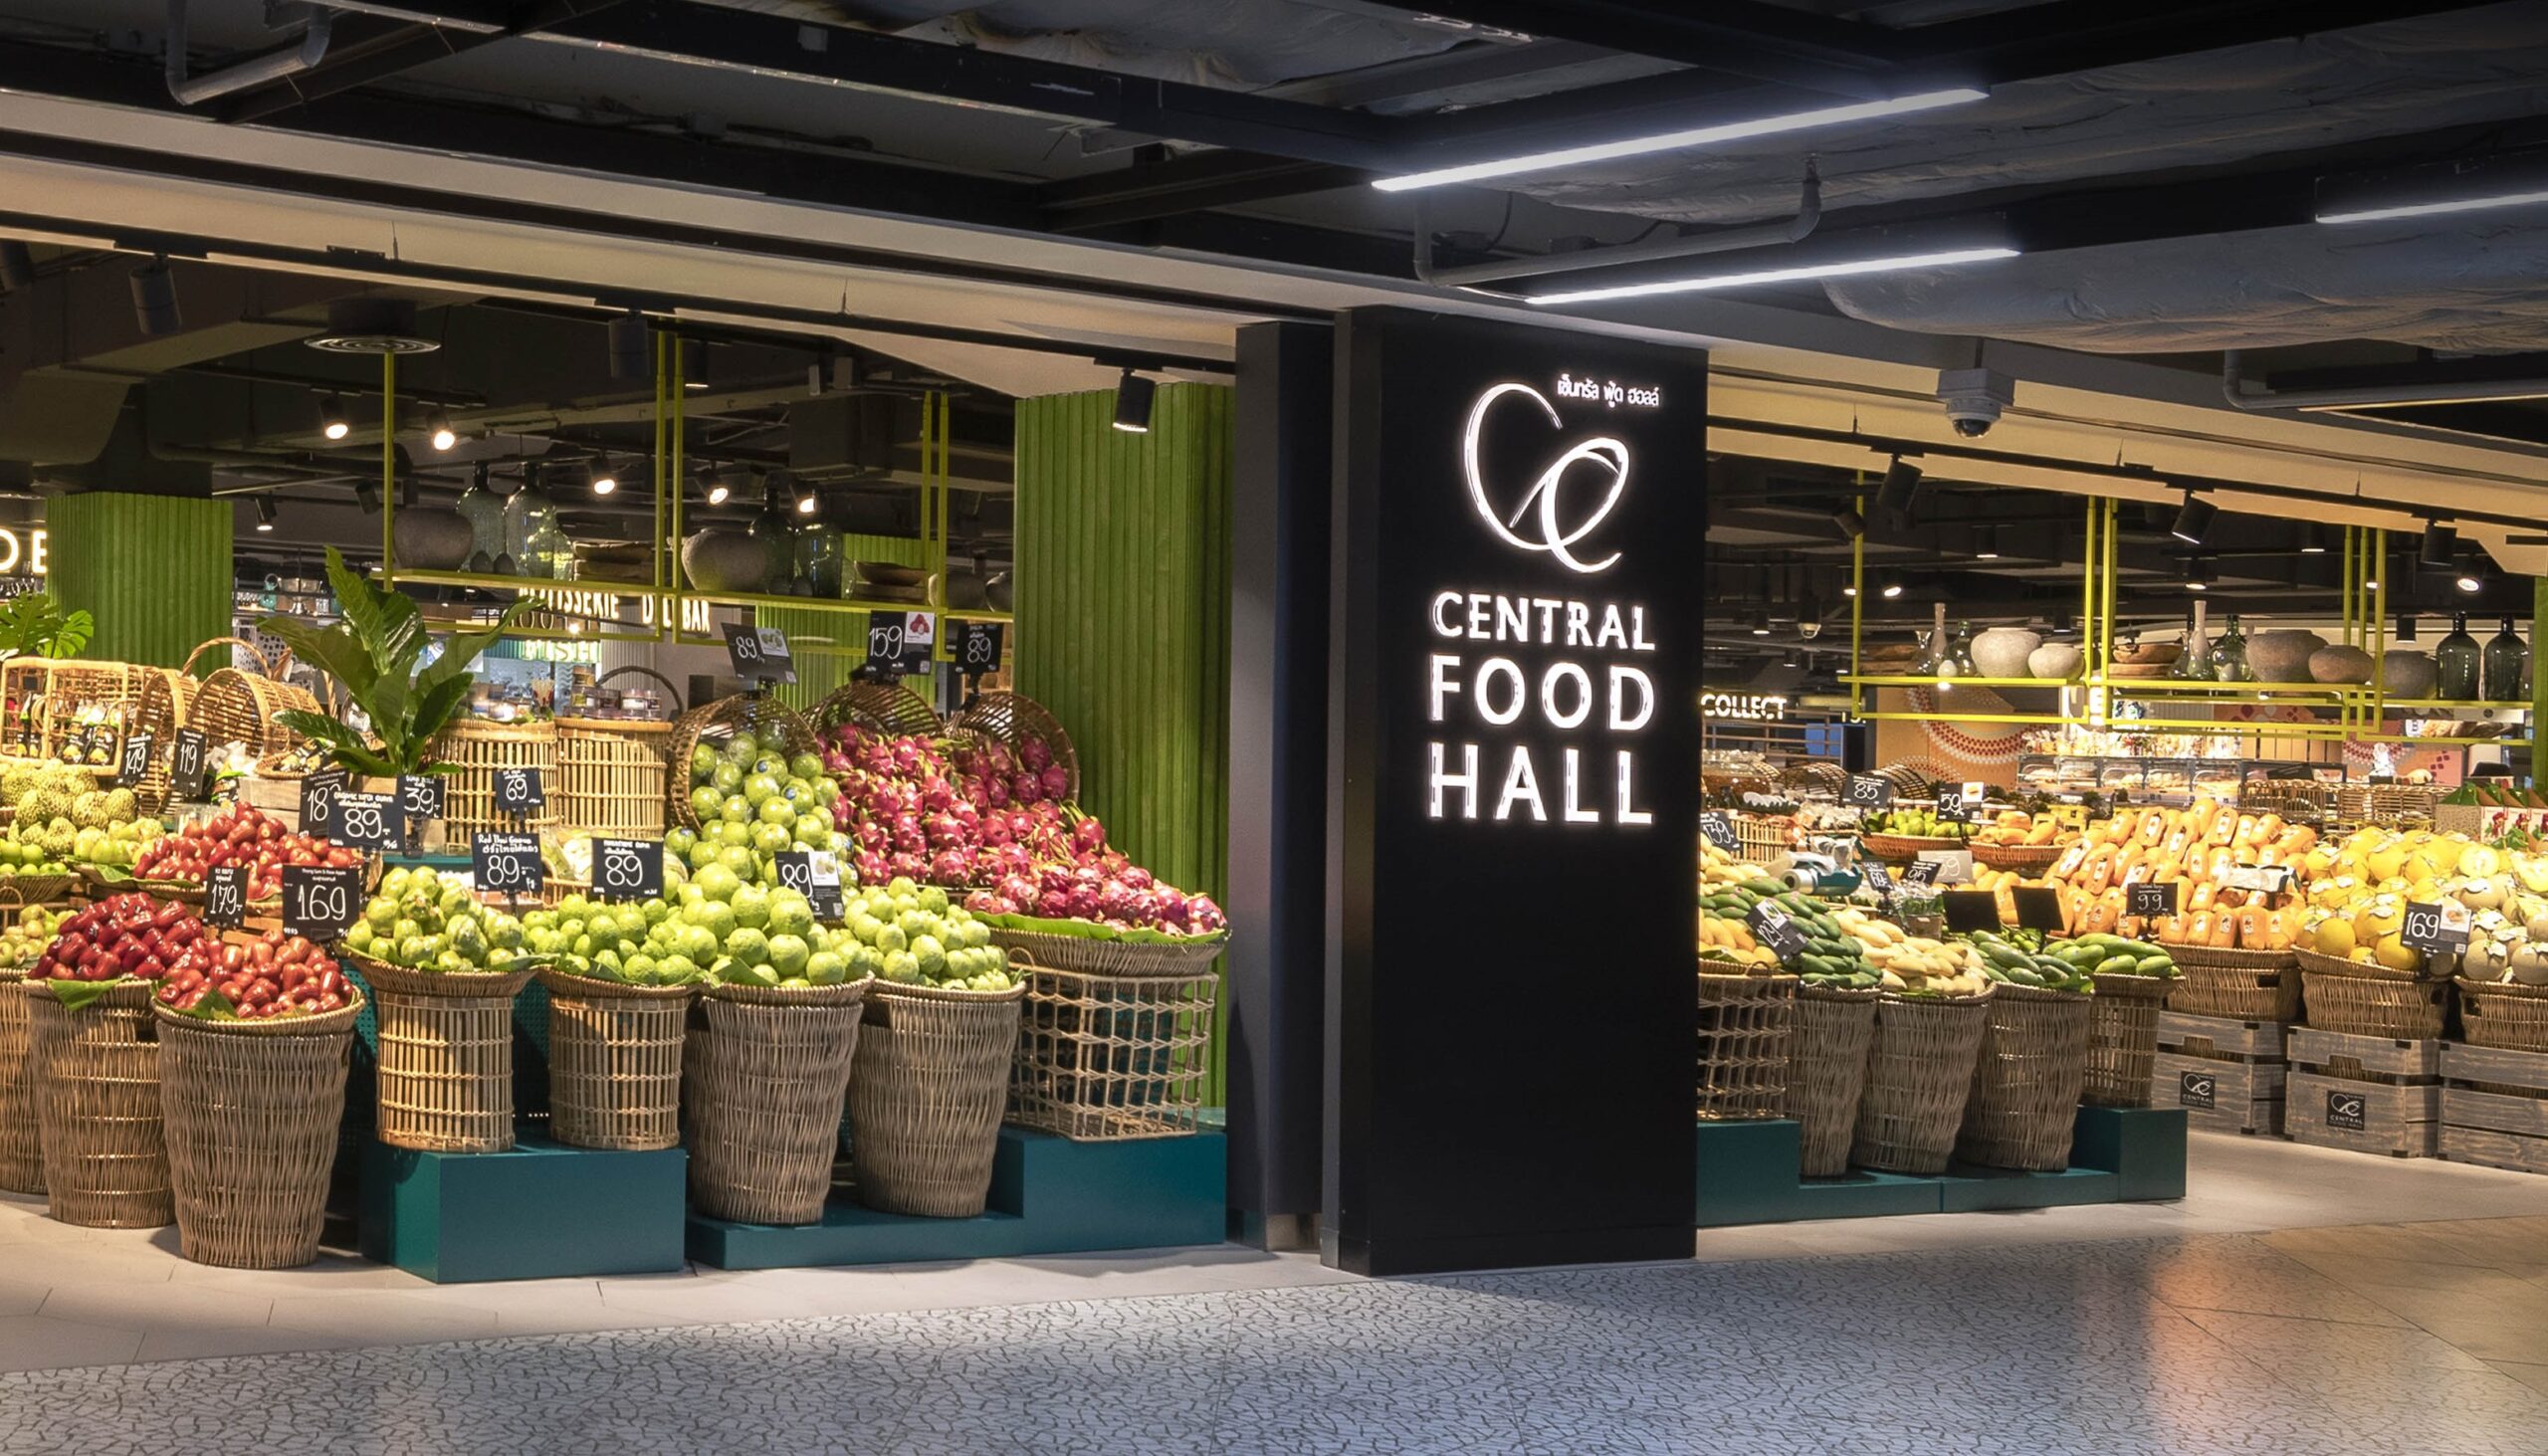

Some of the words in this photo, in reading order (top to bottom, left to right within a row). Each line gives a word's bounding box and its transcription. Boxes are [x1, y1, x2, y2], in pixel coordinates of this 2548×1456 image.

[1558, 373, 1599, 400] เซ็นทรัล
[1603, 380, 1623, 408] ฟู้ด
[1627, 387, 1659, 406] ฮอลล์
[683, 599, 711, 632] BAR
[1432, 591, 1656, 651] CENTRAL
[736, 636, 757, 659] 89
[869, 625, 903, 660] 159
[967, 637, 991, 663] 89
[1430, 655, 1654, 731] FOOD
[1701, 694, 1787, 720] COLLECT
[124, 746, 146, 774] 149
[179, 743, 197, 775] 119
[506, 777, 528, 801] 69
[1430, 742, 1653, 824] HALL
[1854, 783, 1878, 799] 85
[404, 786, 435, 814] 39
[1941, 793, 1962, 812] 59
[344, 808, 382, 839] 89
[487, 855, 520, 885] 89
[604, 855, 644, 887] 89
[210, 884, 238, 915] 179
[296, 884, 346, 921] 169
[2138, 894, 2162, 912] 99
[2406, 912, 2440, 939] 169
